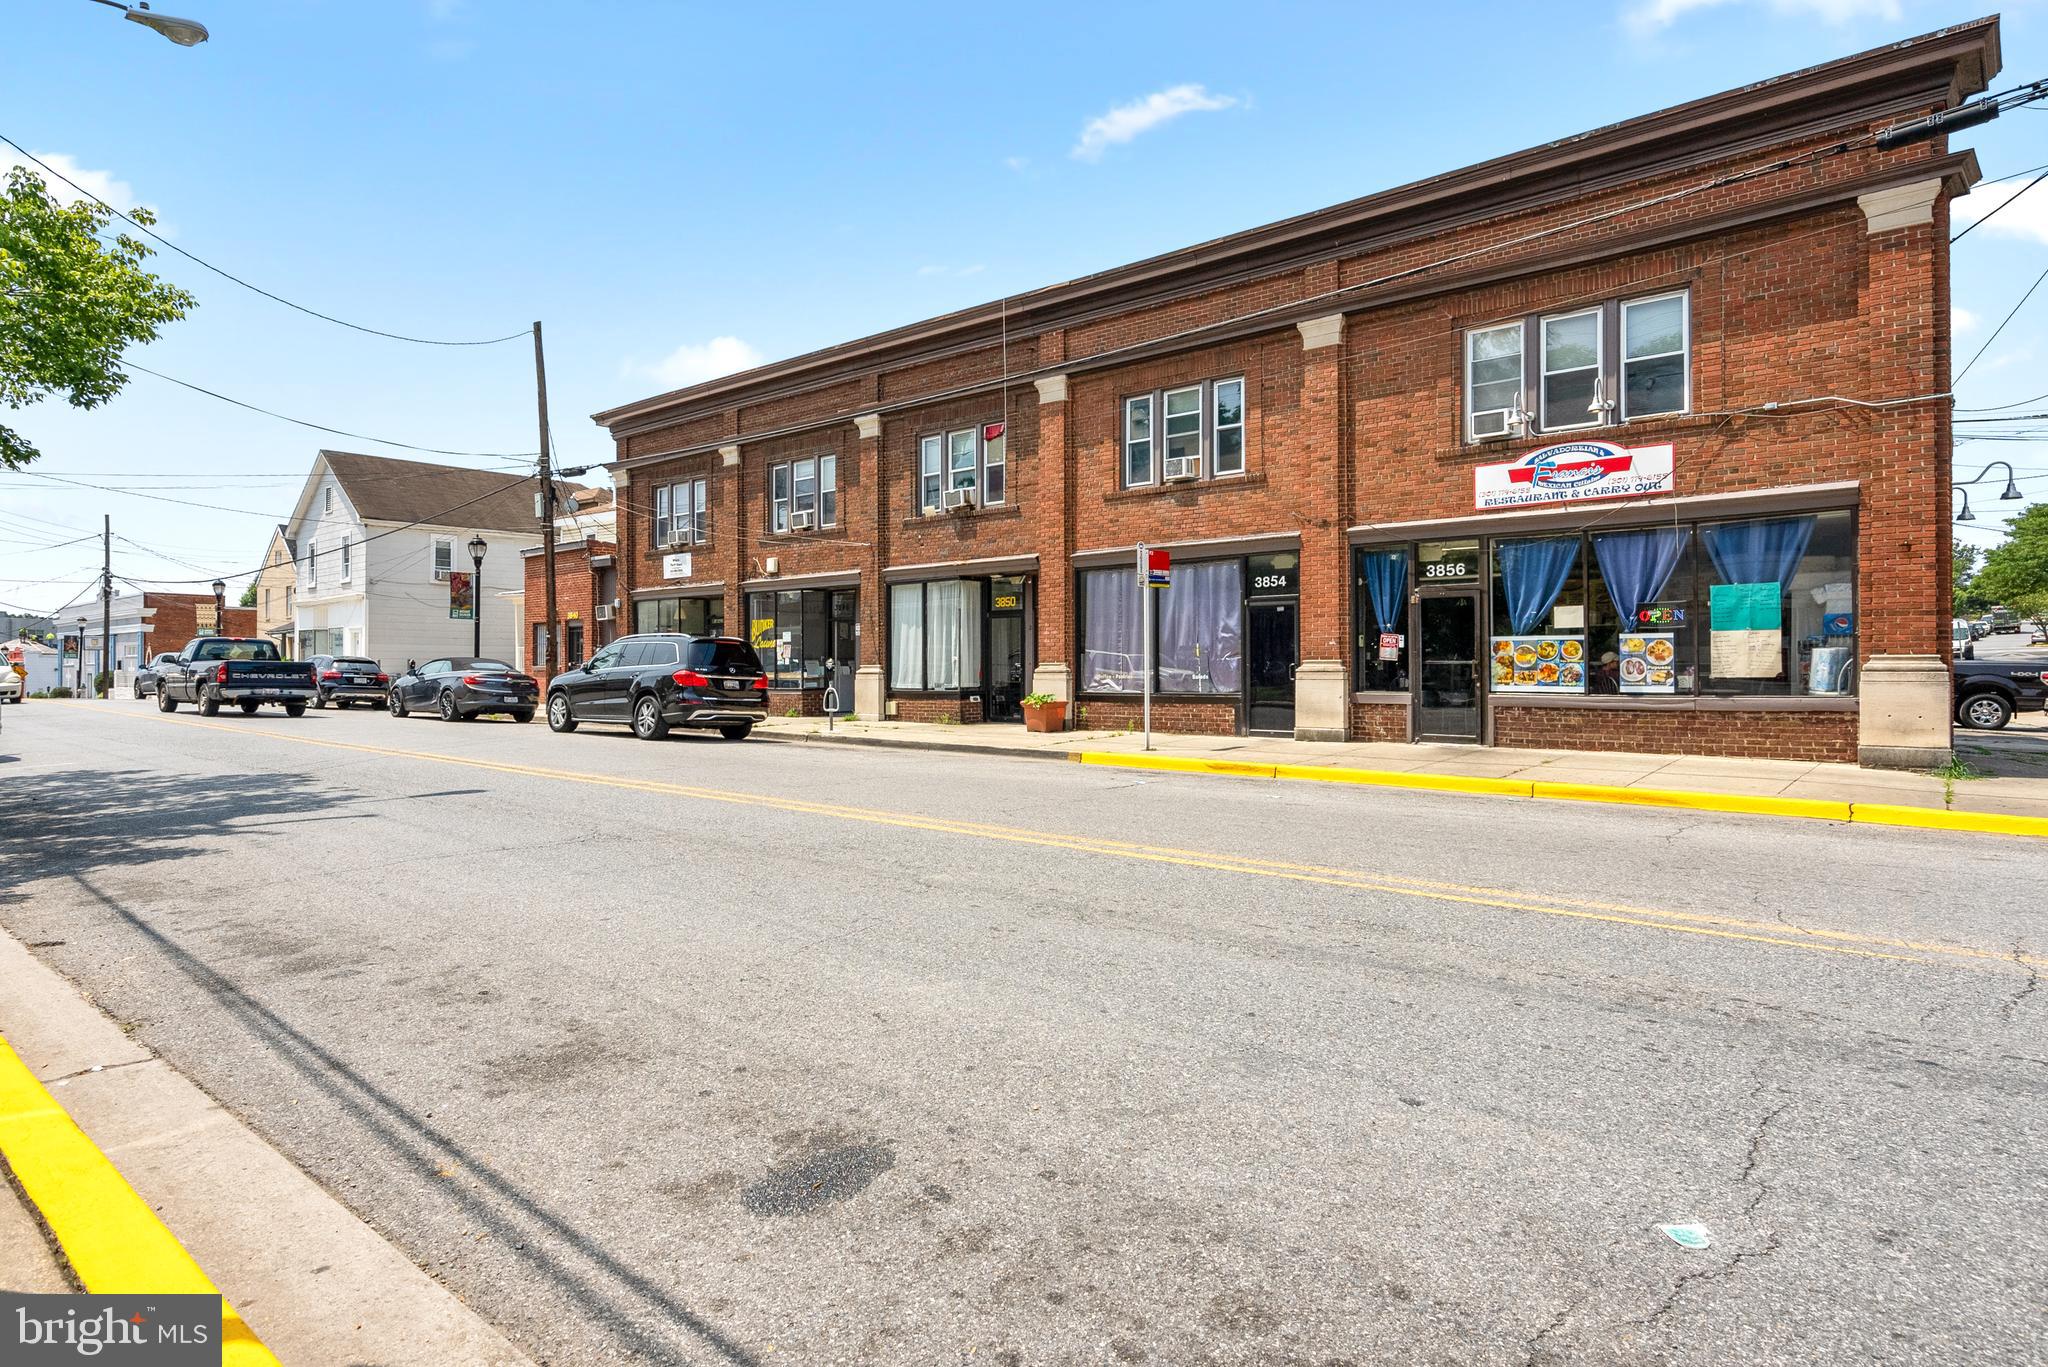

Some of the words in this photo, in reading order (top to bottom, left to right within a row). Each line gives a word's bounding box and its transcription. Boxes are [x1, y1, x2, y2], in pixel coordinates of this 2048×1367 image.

[1533, 461, 1604, 488] Francis
[1484, 491, 1568, 506] RESTAURANT
[1571, 489, 1580, 498] &
[1583, 484, 1631, 497] CARRY
[1426, 563, 1466, 577] 3856
[1254, 575, 1287, 588] 3854
[995, 596, 1016, 608] 3850
[1639, 609, 1684, 622] OPEN
